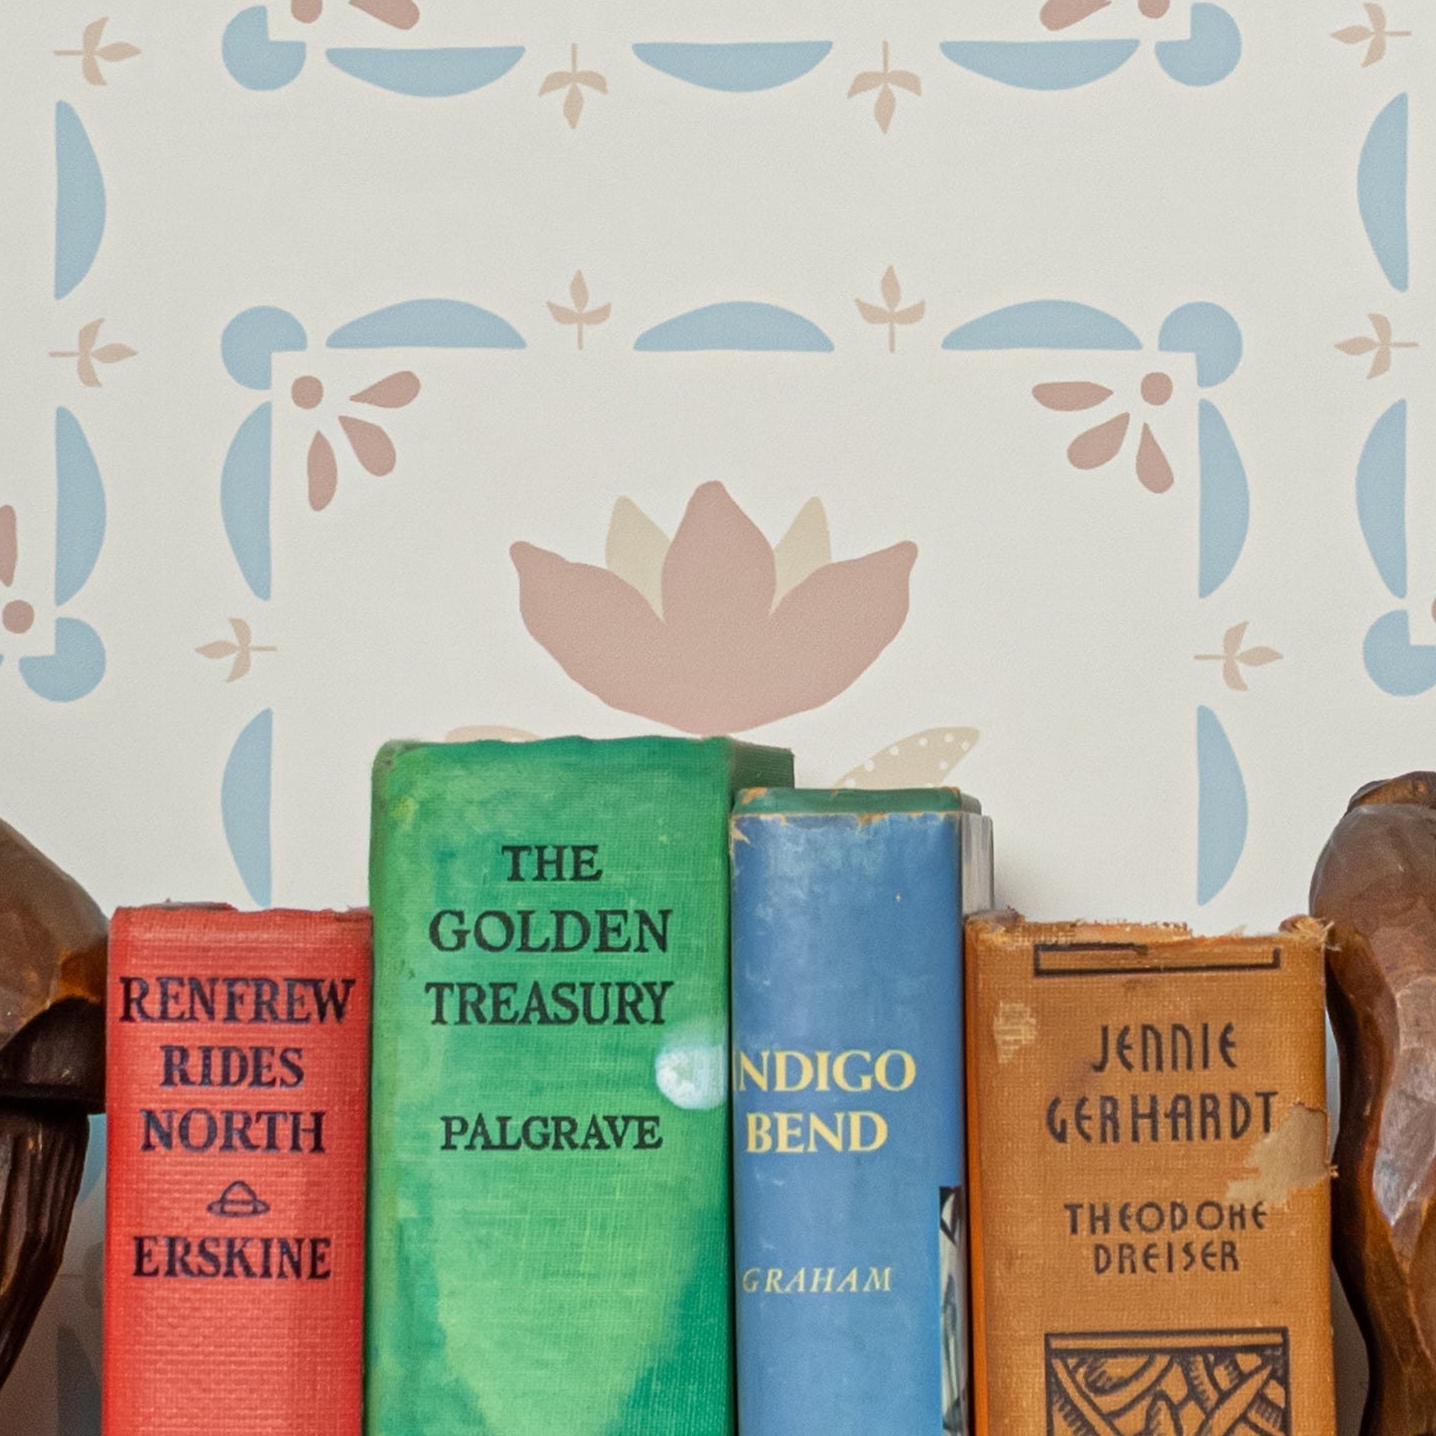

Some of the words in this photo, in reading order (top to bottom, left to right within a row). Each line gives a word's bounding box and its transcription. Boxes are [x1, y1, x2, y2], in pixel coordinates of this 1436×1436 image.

[501, 844, 603, 882] THE
[428, 909, 673, 953] GOLDEN
[118, 976, 357, 1024] RENFREW
[424, 980, 674, 1026] TREASURY
[159, 1044, 305, 1089] RIDES
[1091, 1021, 1237, 1073] JENNIE
[140, 1108, 328, 1154] NORTH
[440, 1113, 663, 1151] PALGRAVE
[745, 1111, 889, 1153] BEND
[1046, 1090, 1279, 1144] GERHARDT
[132, 1235, 332, 1281] ERSKINE
[742, 1266, 892, 1294] GRAHAM
[1093, 1240, 1240, 1275] DREISER
